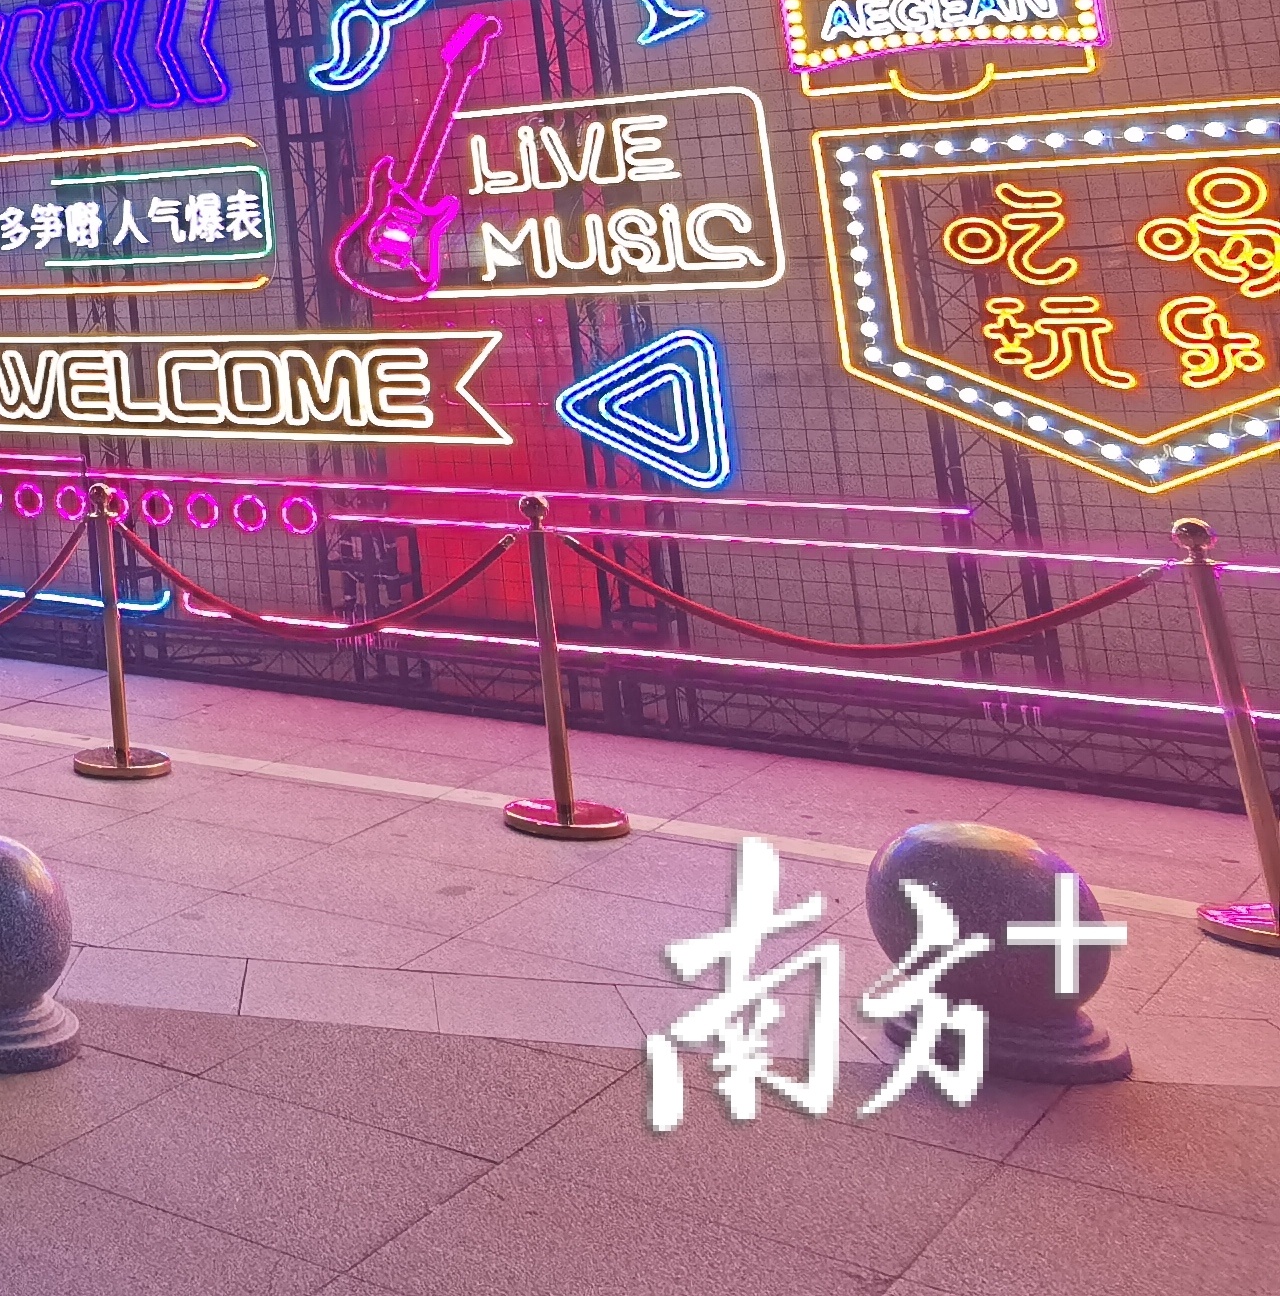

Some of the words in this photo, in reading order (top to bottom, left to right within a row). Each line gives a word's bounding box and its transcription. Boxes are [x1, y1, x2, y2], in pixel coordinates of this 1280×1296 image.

[468, 114, 682, 195] LIVE
[481, 202, 766, 282] MUSIC
[983, 295, 1265, 389] 玩乐
